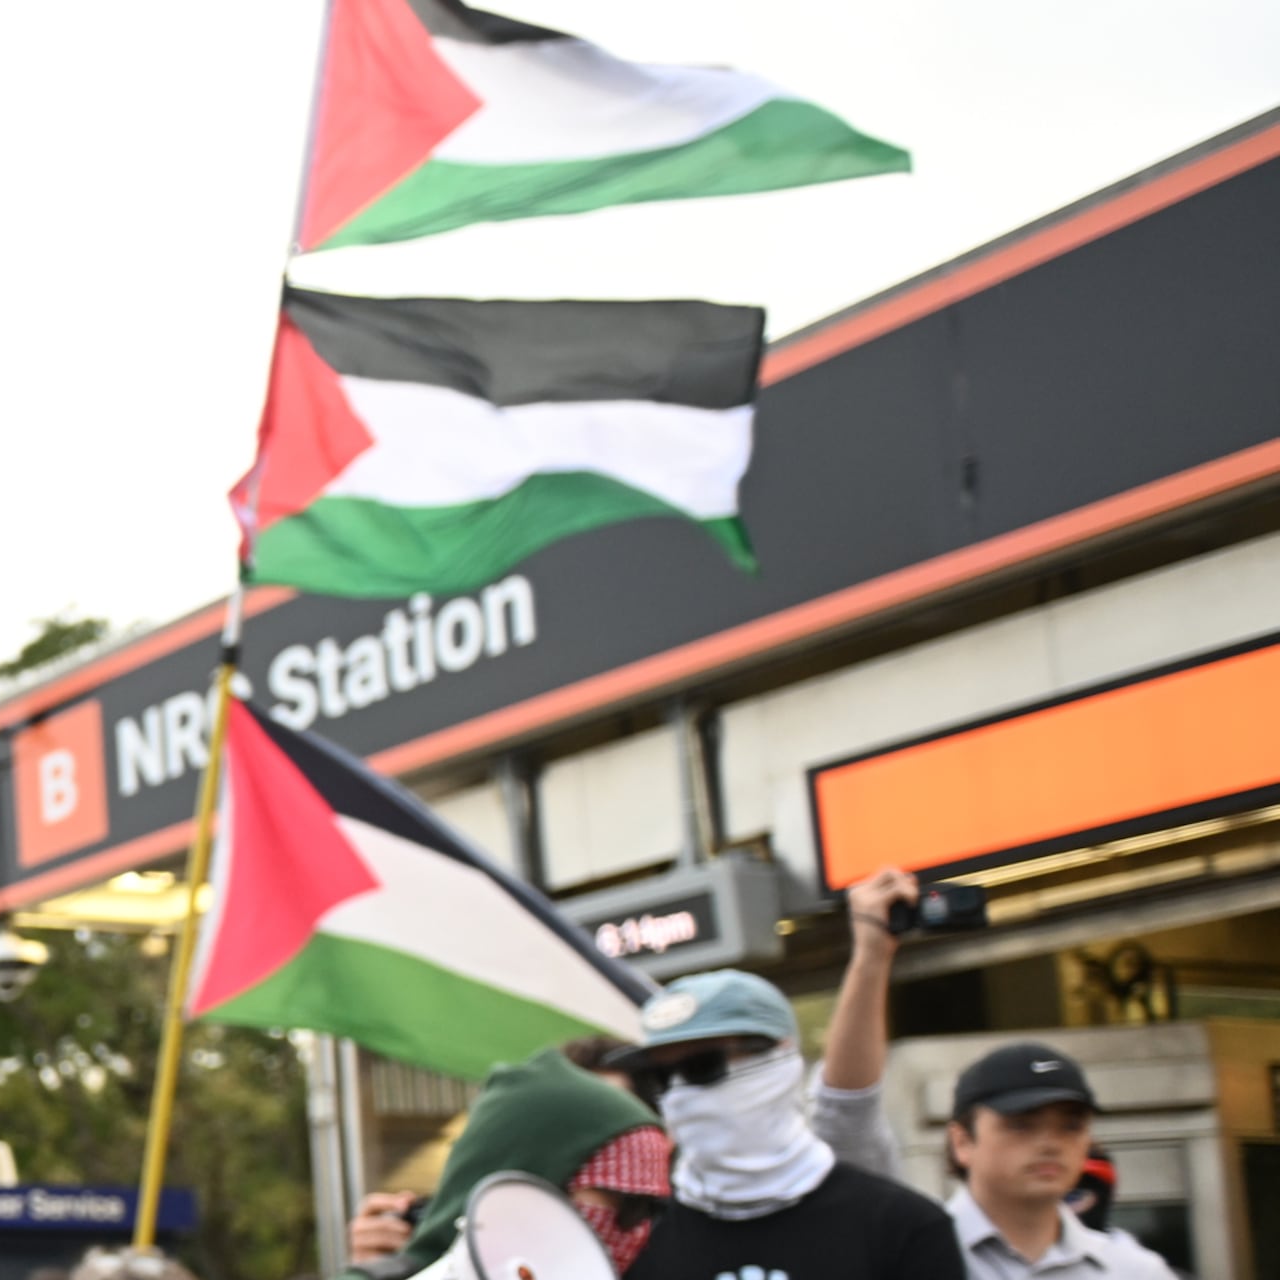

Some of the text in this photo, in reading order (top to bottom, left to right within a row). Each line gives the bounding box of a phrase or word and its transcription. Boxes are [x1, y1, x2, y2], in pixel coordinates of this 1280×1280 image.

[38, 746, 79, 826] B
[268, 574, 537, 733] Station
[27, 1187, 125, 1222] Service
